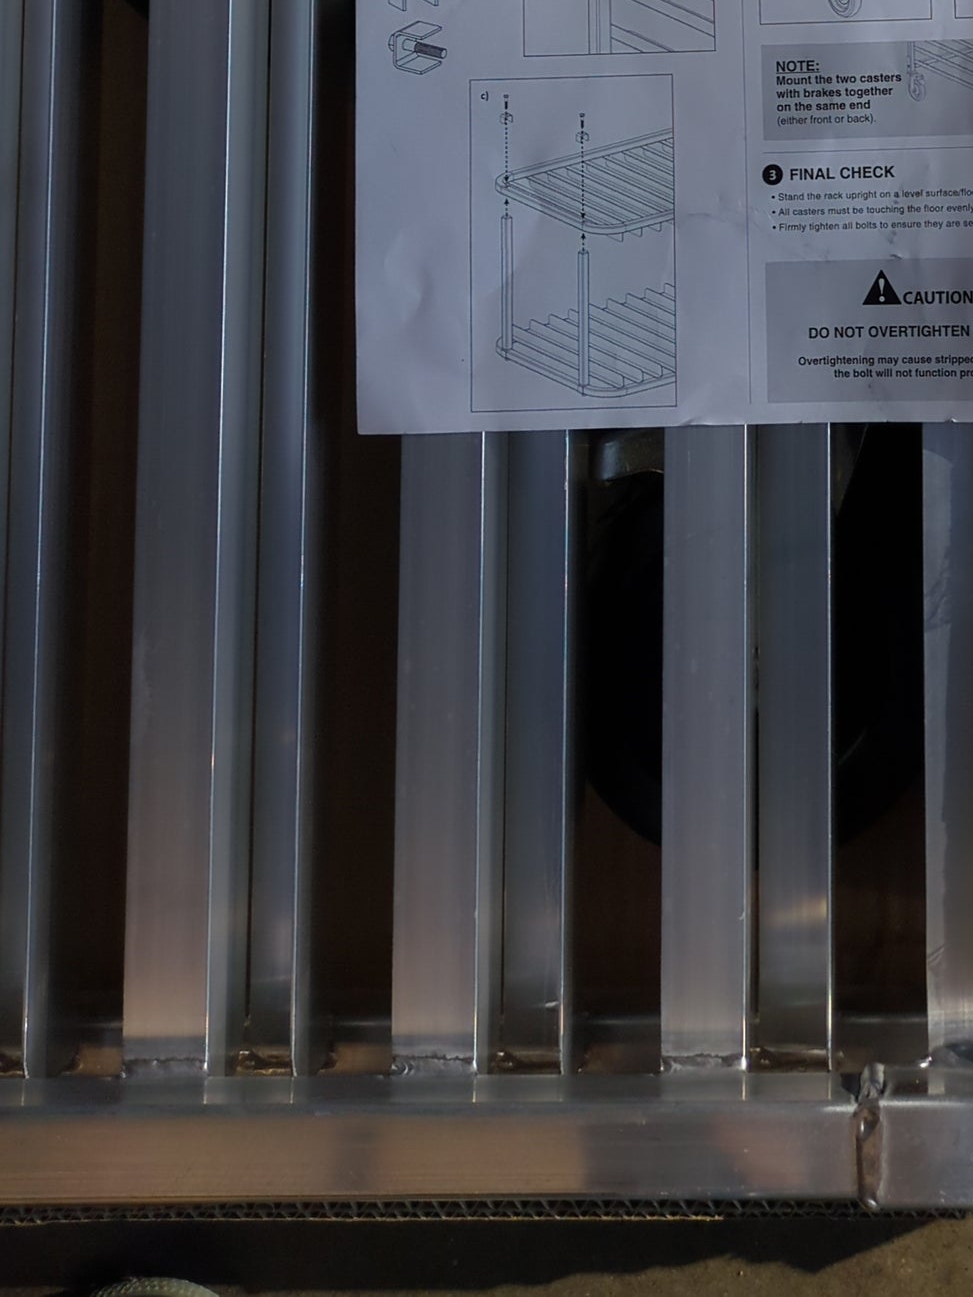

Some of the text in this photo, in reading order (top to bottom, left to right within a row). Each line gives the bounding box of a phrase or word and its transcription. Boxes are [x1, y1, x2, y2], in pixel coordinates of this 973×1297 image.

[775, 59, 819, 73] NOTE:
[775, 73, 902, 85] Mount the two casters
[480, 90, 489, 102] c)
[775, 86, 893, 99] with brakes together
[776, 99, 871, 112] on the same end
[776, 115, 808, 126] (either
[809, 114, 832, 124] front
[834, 115, 845, 124] or
[789, 167, 835, 181] FINAL
[839, 165, 895, 179] CHECK
[777, 192, 805, 201] Stand
[806, 192, 822, 200] the
[823, 191, 843, 200] rack
[845, 190, 877, 201] upright
[901, 188, 924, 198] level
[777, 207, 790, 216] All
[792, 208, 825, 216] casters
[827, 206, 850, 215] must
[852, 205, 864, 214] be
[866, 205, 905, 215] touching
[906, 204, 921, 213] the
[923, 203, 944, 213] floor
[903, 290, 973, 305] CAUTION
[808, 326, 830, 339] DO
[833, 325, 864, 338] NOT
[867, 324, 970, 337] OVERTIGHTEN
[797, 355, 875, 367] Overtightening
[877, 356, 899, 366] may
[901, 356, 932, 364] cause
[833, 368, 850, 378] the
[852, 368, 873, 378] bolt
[874, 367, 892, 377] will
[895, 368, 912, 378] not
[914, 367, 957, 377] function
